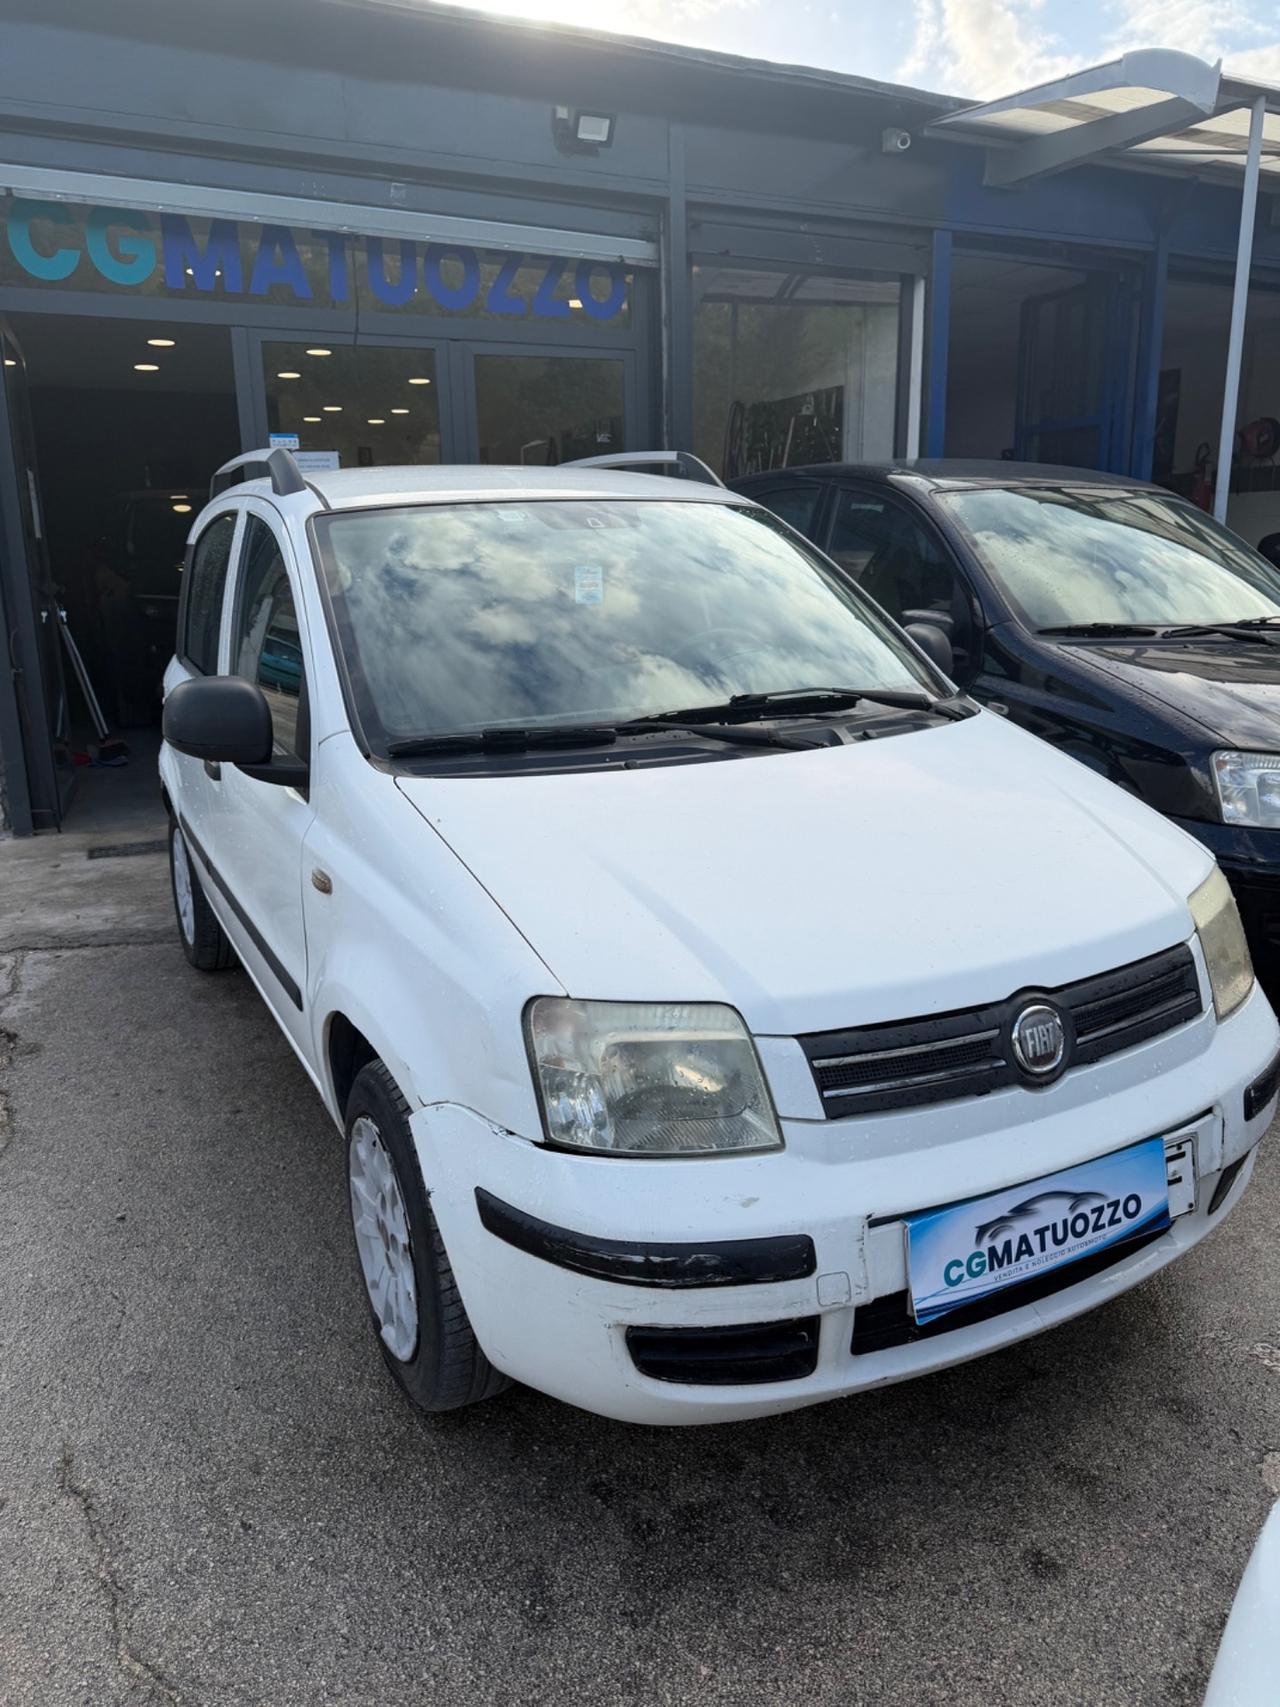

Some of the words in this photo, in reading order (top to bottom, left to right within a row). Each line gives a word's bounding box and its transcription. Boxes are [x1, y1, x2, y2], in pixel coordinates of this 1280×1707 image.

[6, 199, 626, 320] CGMATUOZZO
[1025, 1022, 1054, 1058] FIAT
[944, 1194, 1141, 1287] CGMATUOZZO
[994, 1267, 1023, 1280] VENDITA
